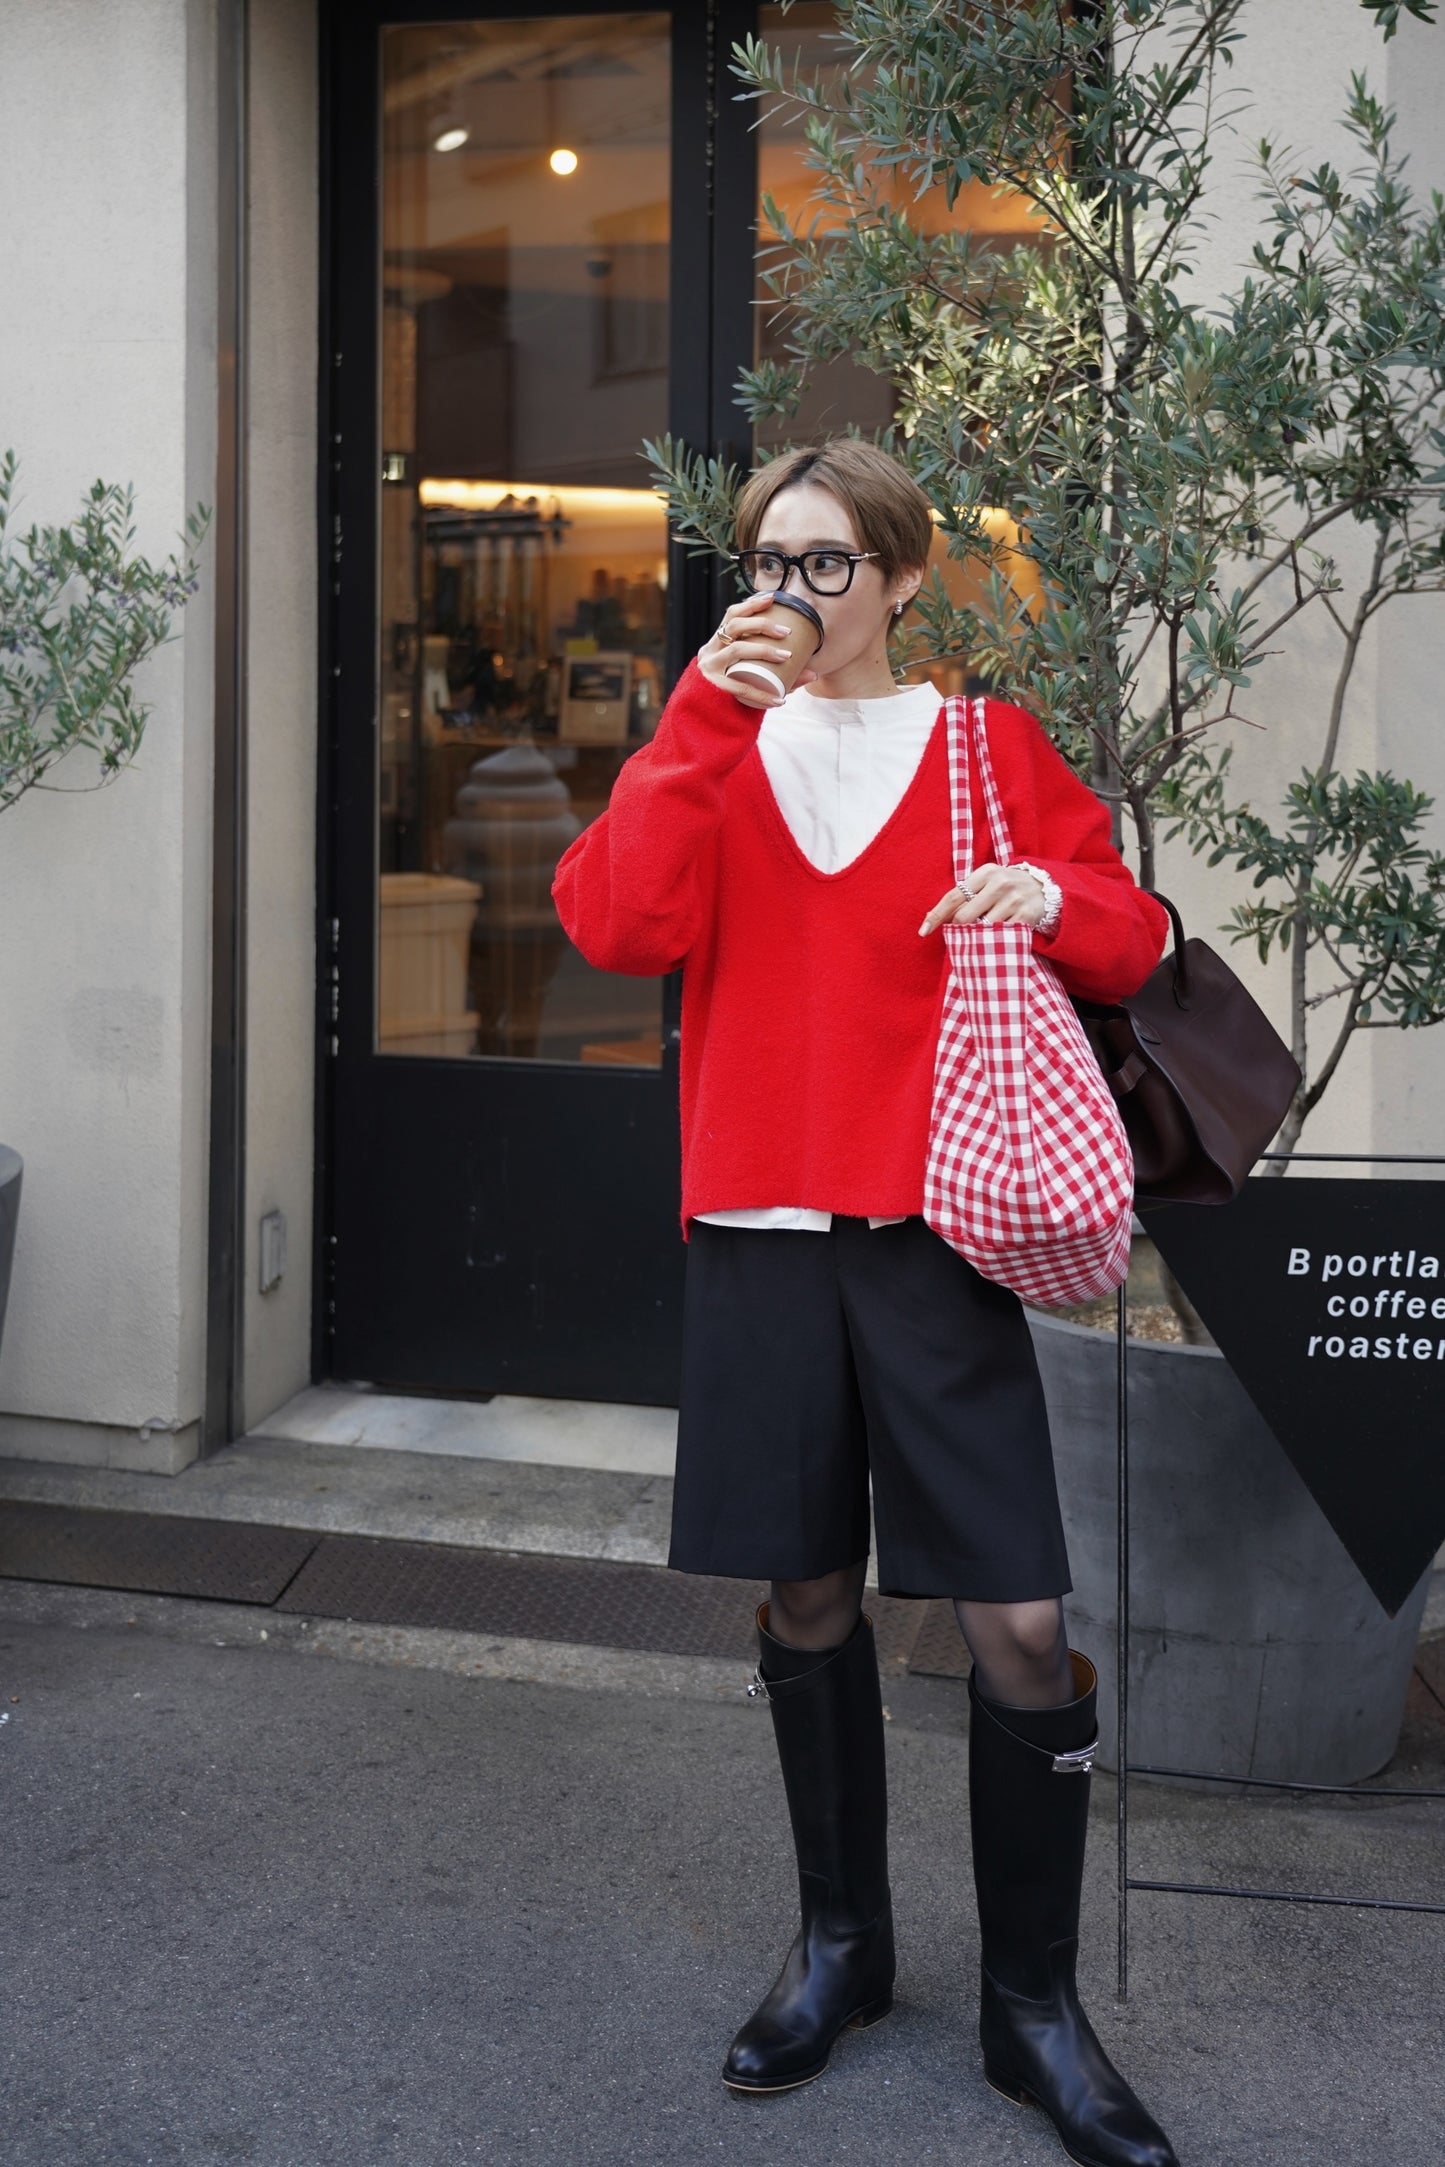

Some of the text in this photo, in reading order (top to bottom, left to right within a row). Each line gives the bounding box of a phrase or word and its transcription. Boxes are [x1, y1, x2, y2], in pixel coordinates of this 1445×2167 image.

[1287, 1248, 1445, 1282] B portla
[1327, 1289, 1445, 1319] coffee
